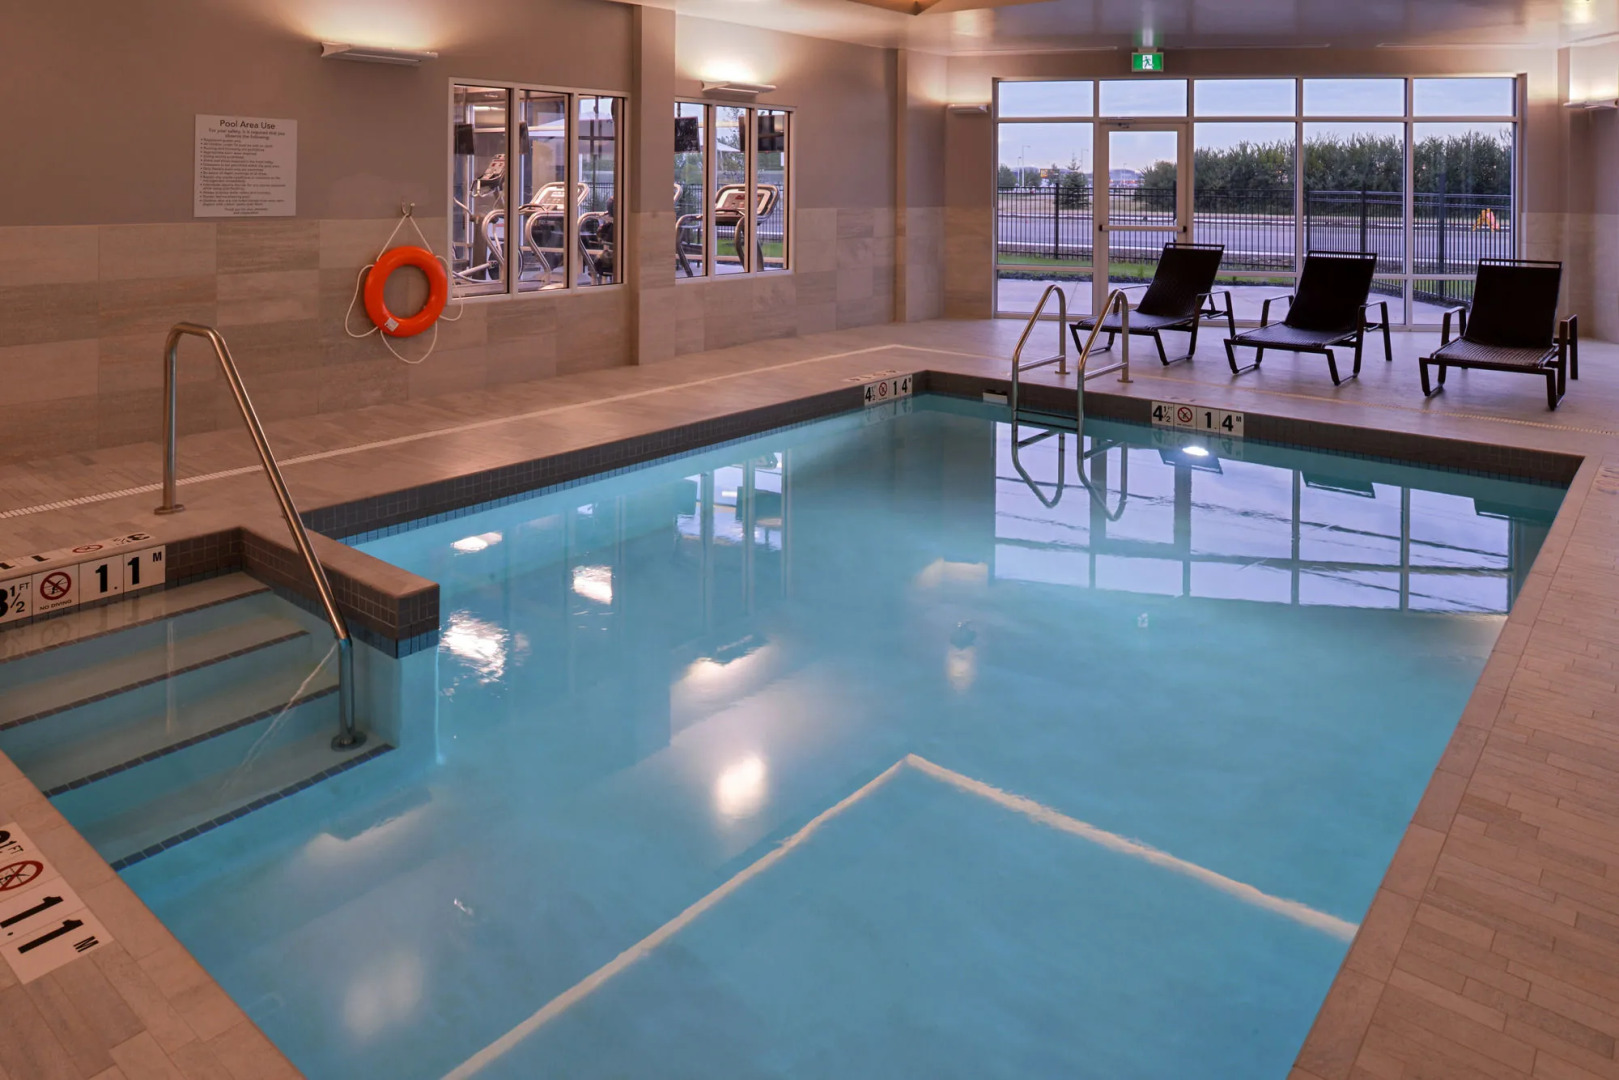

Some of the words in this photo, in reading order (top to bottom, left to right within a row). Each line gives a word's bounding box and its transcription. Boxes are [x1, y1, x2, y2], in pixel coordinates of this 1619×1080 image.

[219, 119, 238, 128] Pool
[240, 120, 259, 129] Area
[260, 121, 276, 130] Use
[51, 599, 73, 609] DIVING
[152, 551, 163, 563] M
[73, 935, 100, 953] M
